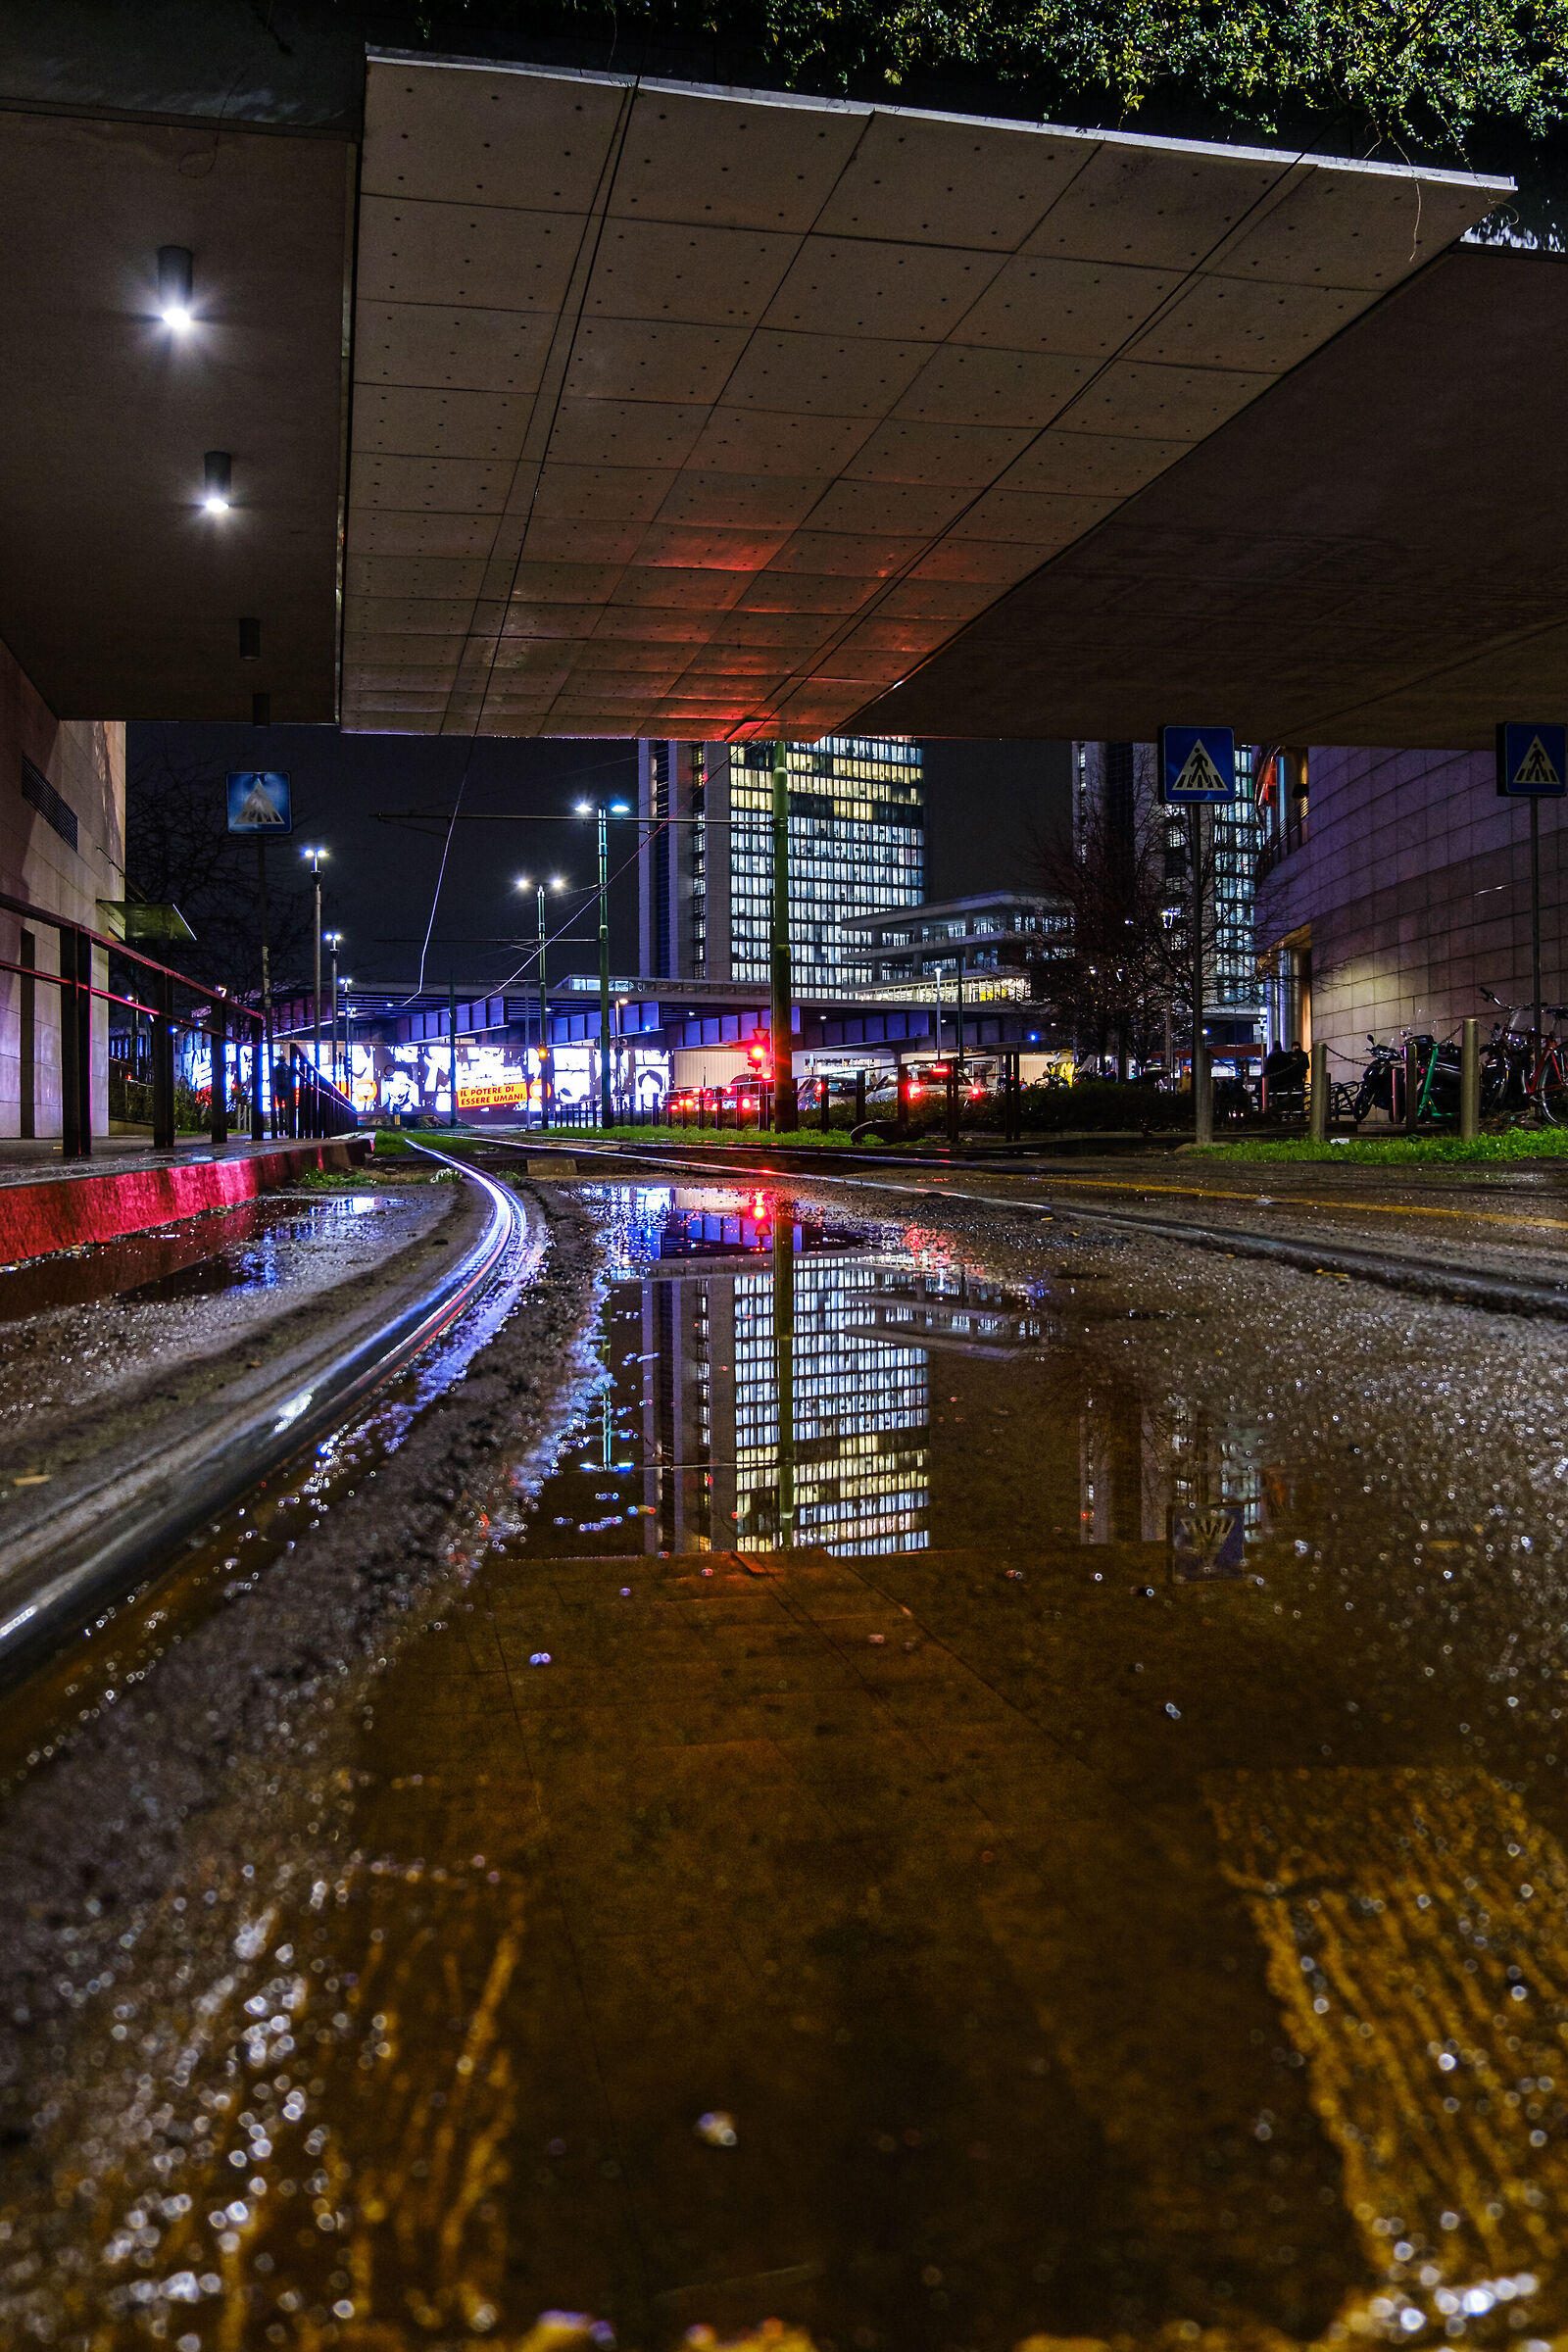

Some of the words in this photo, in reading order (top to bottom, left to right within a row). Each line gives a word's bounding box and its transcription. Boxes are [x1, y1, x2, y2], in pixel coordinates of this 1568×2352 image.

[470, 1087, 502, 1096] POTERE
[461, 1097, 490, 1105] ESSERE
[493, 1094, 525, 1102] UMANI.
